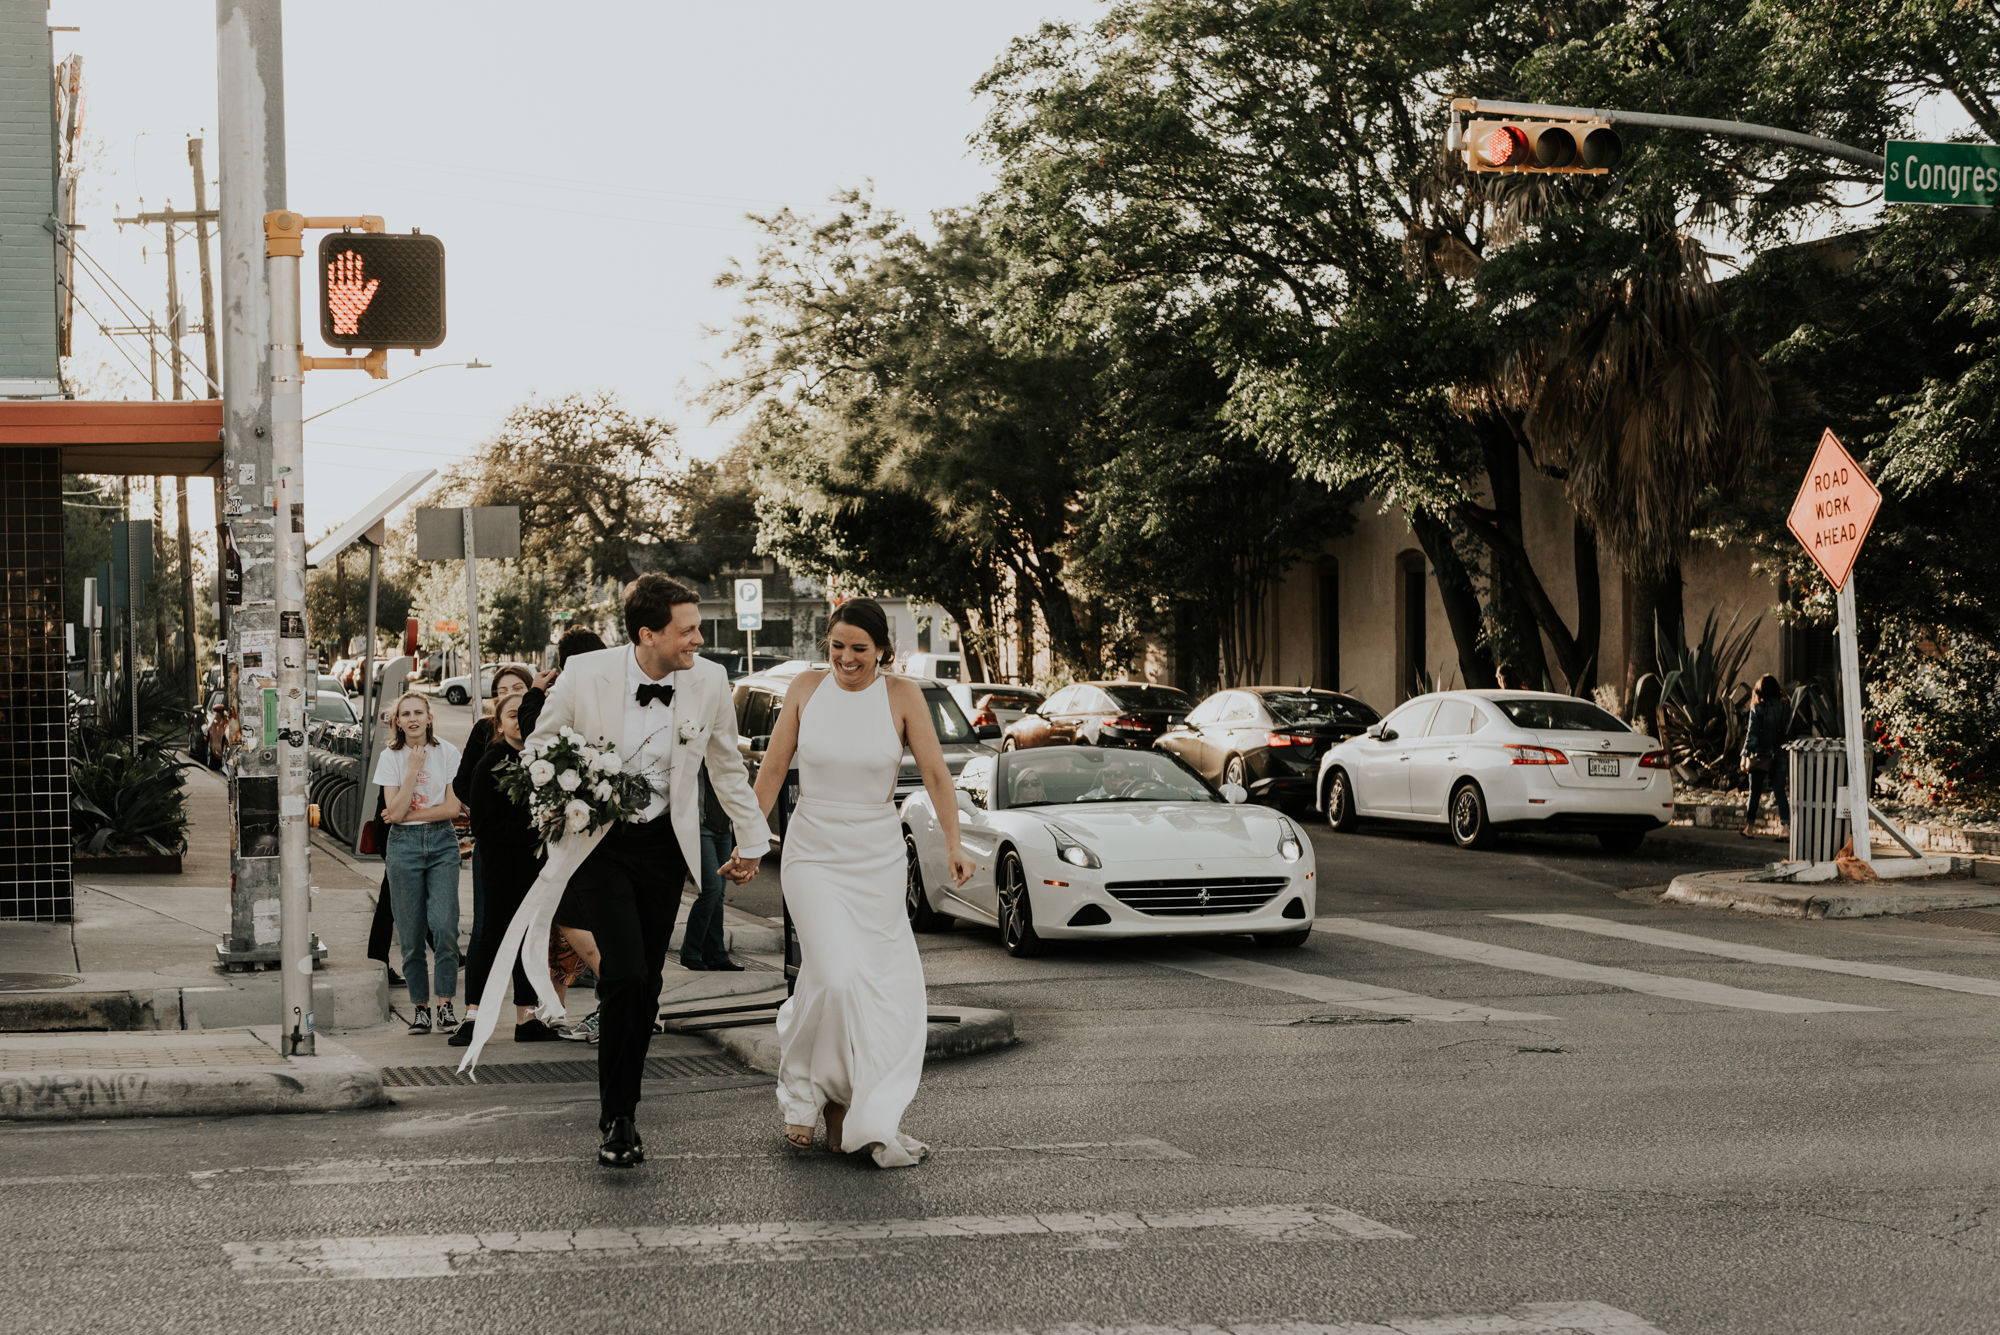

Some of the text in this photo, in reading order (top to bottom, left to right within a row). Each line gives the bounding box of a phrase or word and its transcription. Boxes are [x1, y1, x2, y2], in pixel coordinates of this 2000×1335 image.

[1889, 155, 2000, 199] S Congres
[1814, 468, 1849, 493] ROAD
[1815, 495, 1851, 520] WORK
[1815, 523, 1857, 549] AHEAD
[743, 584, 756, 601] P
[788, 784, 799, 804] PUB
